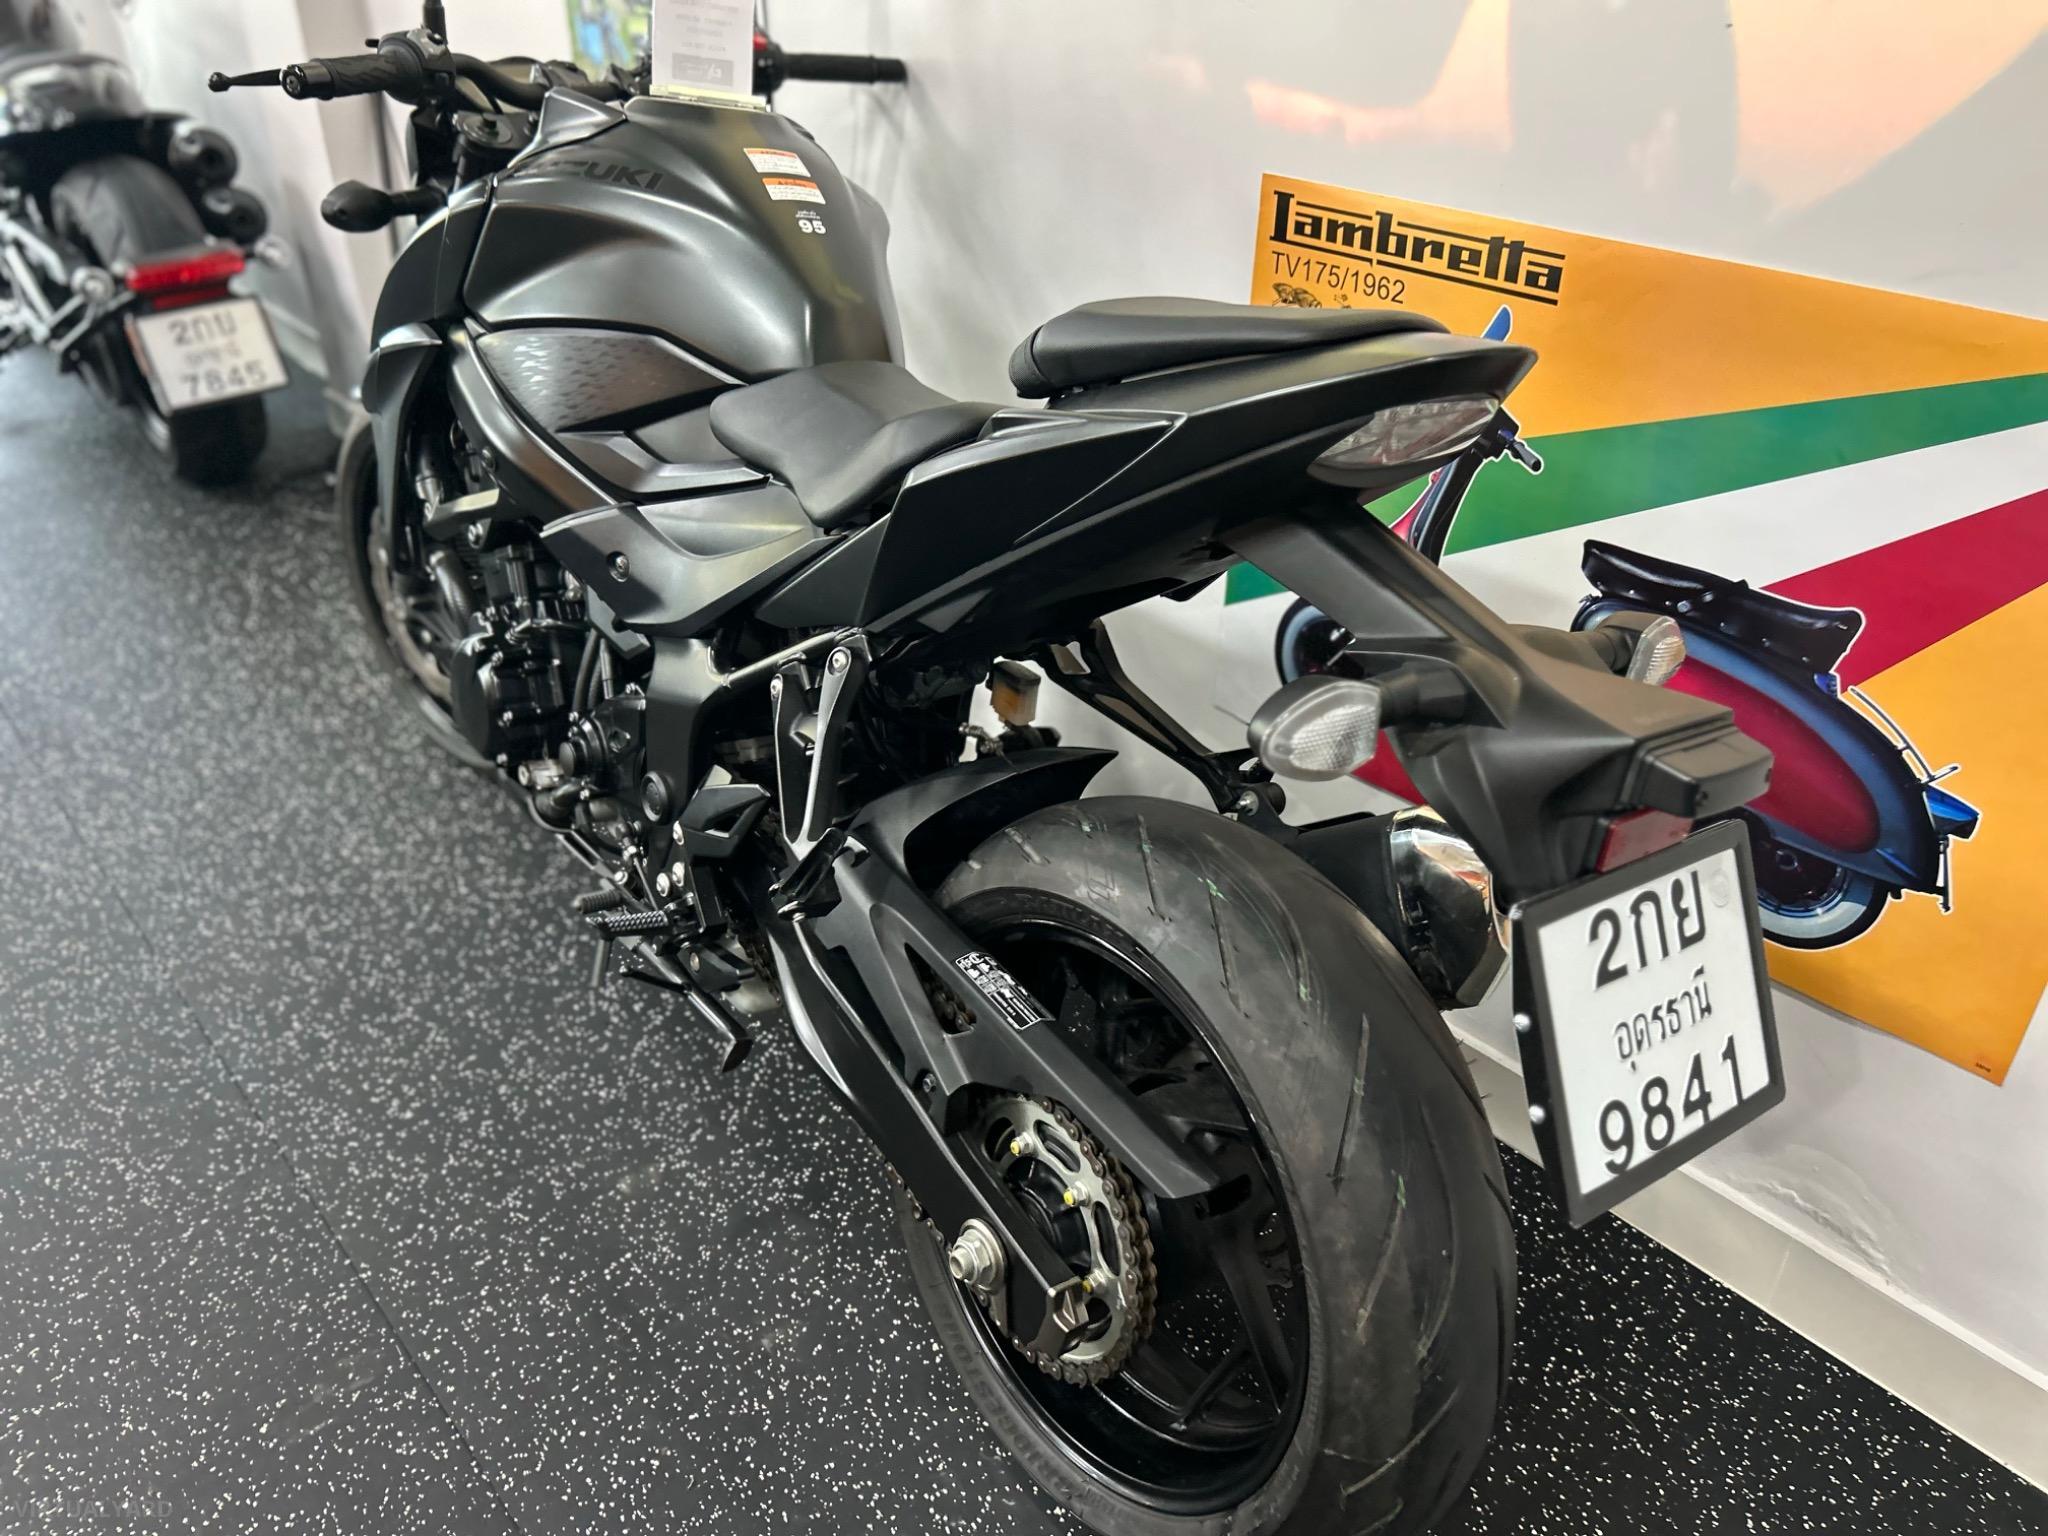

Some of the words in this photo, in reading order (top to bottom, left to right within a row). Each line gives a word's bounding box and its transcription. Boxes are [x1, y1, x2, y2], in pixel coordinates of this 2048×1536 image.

[798, 219, 826, 234] 95
[1270, 190, 1565, 295] Lambretta
[1271, 250, 1406, 305] TV175/1962
[1588, 870, 1706, 990] 2กย
[1613, 966, 1713, 1073] อุดรธานี
[1599, 1034, 1745, 1176] 9841
